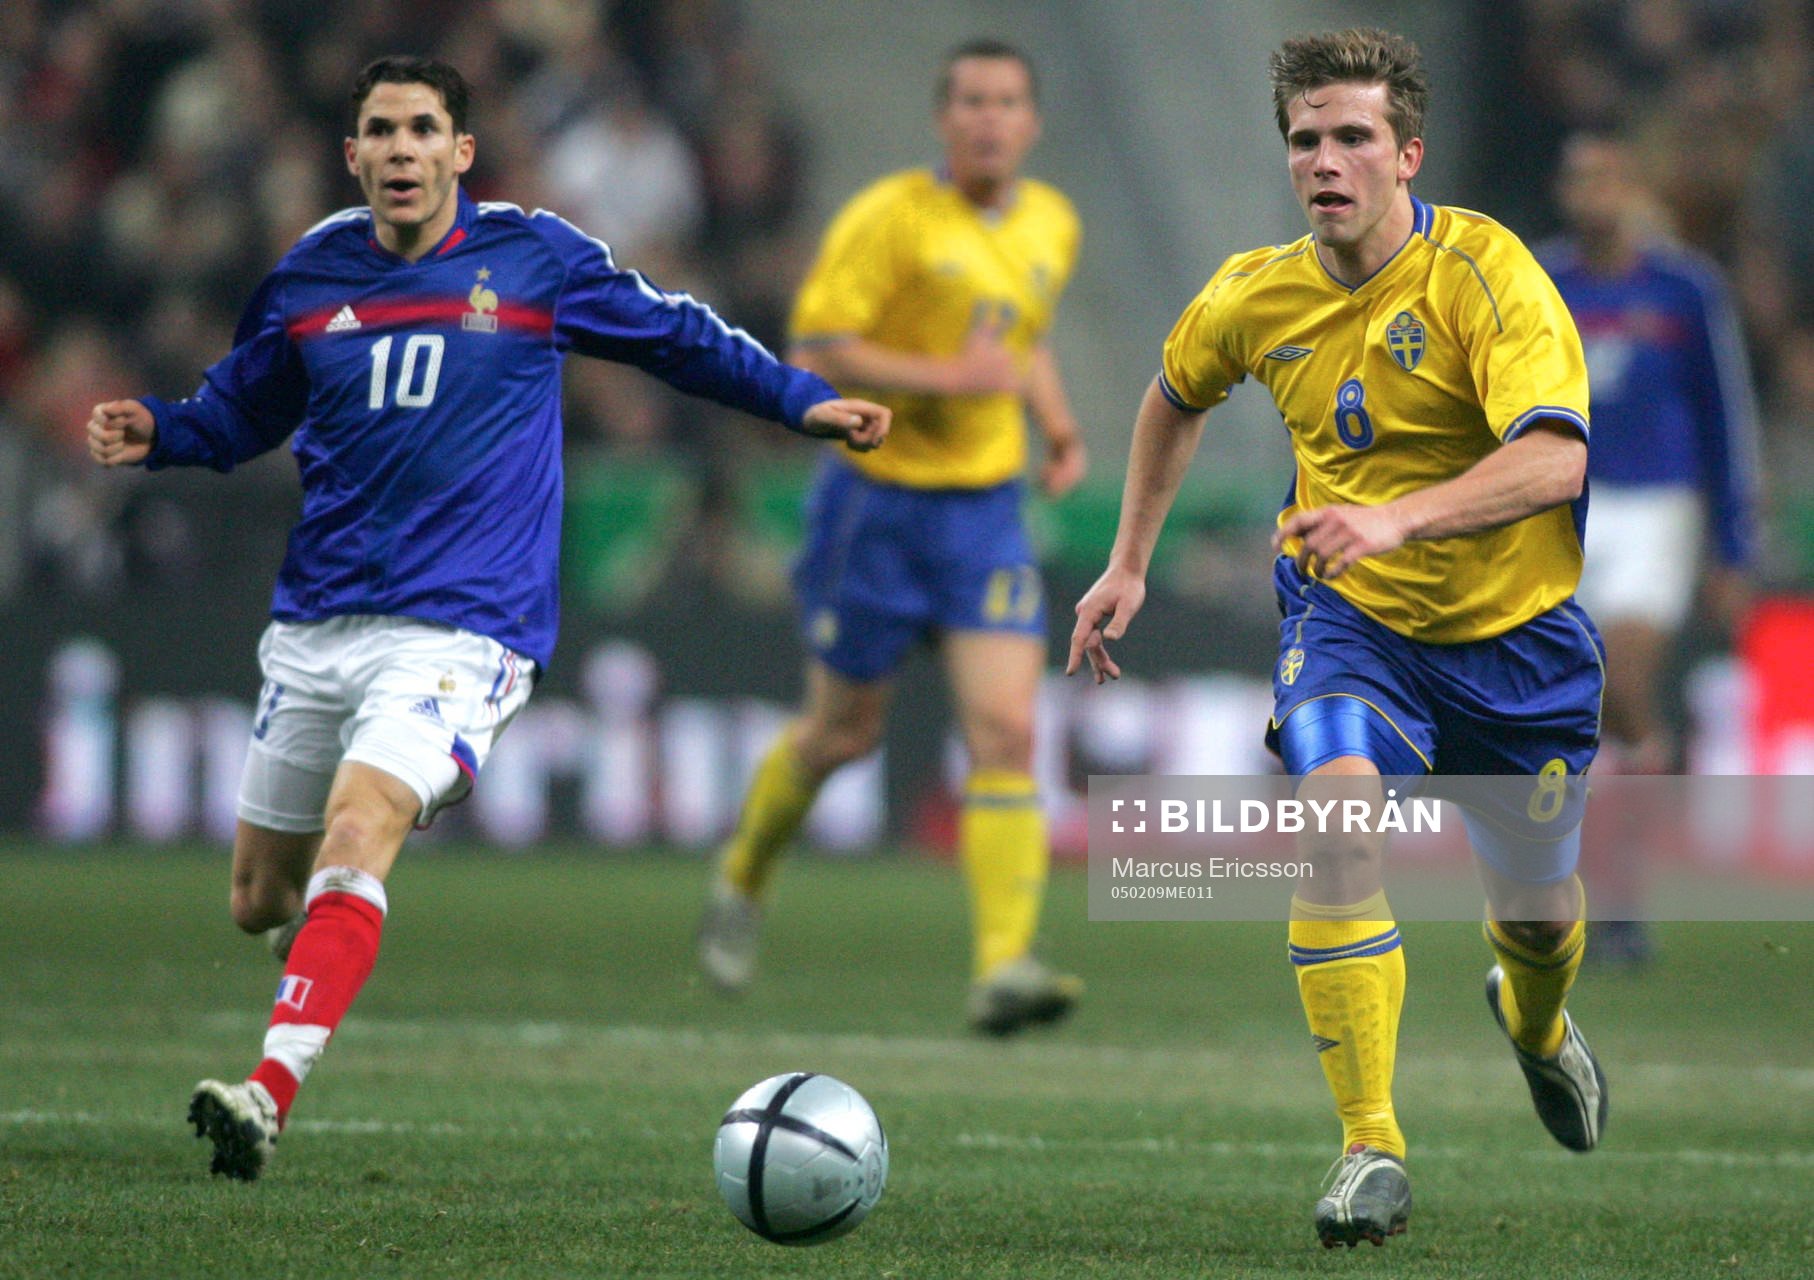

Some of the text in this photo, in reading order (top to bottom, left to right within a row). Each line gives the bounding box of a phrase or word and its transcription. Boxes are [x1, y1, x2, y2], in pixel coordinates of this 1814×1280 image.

[368, 334, 445, 409] 10
[1334, 377, 1374, 450] 8
[1527, 758, 1568, 823] 8
